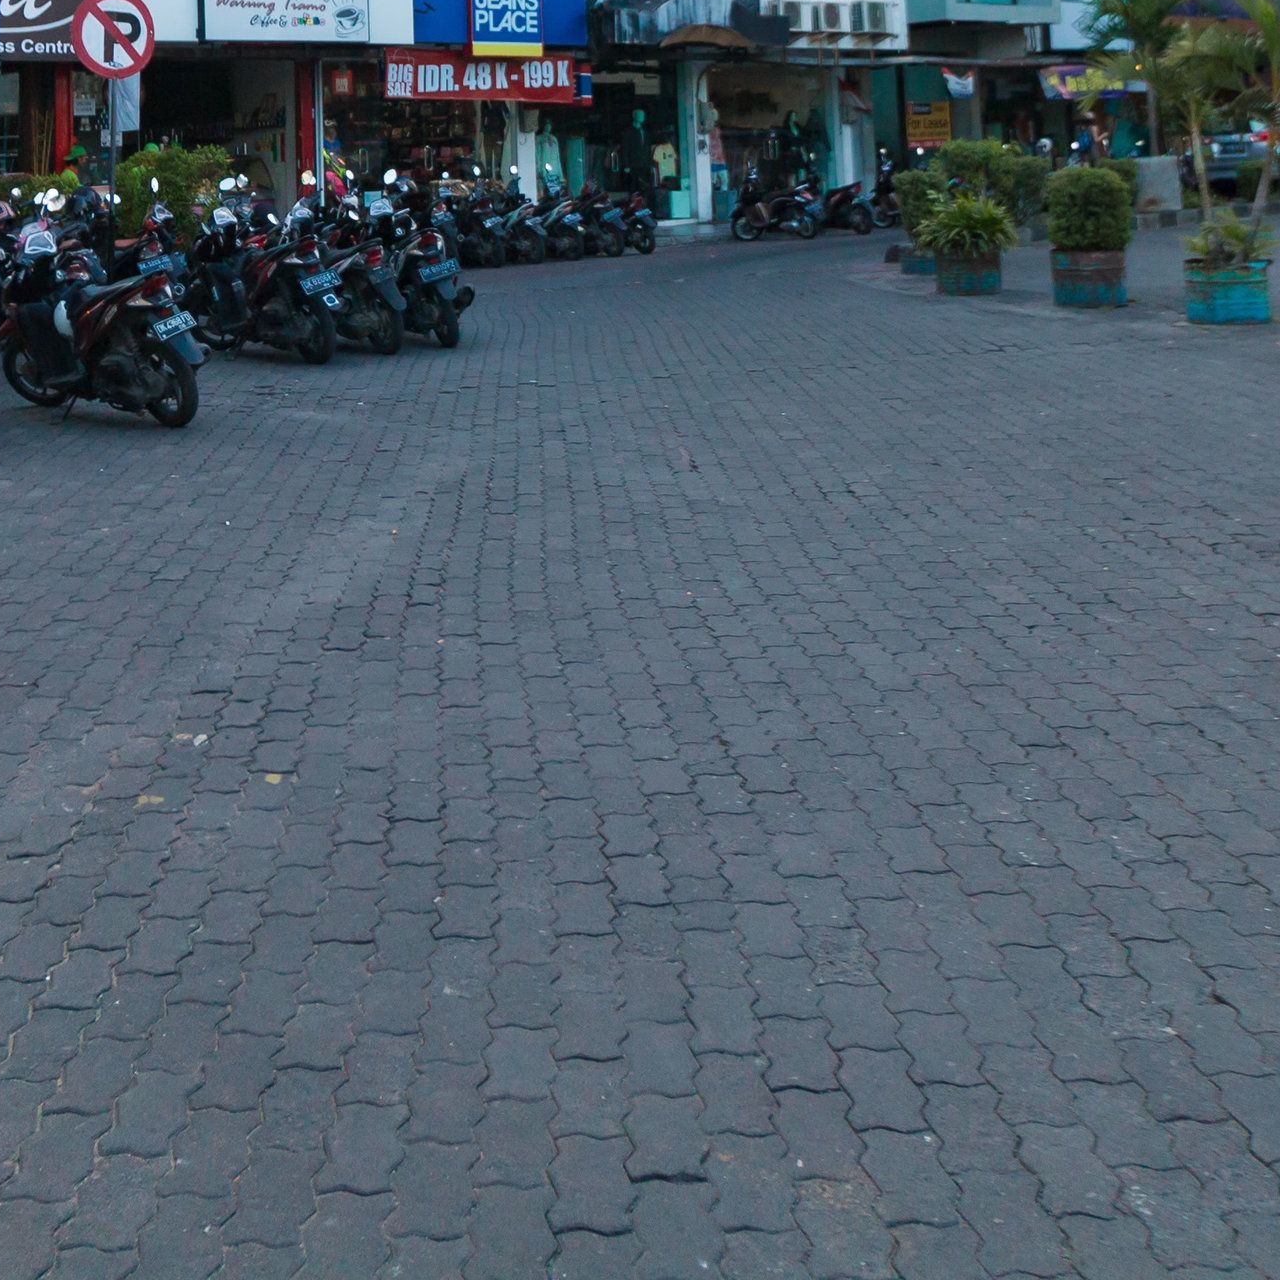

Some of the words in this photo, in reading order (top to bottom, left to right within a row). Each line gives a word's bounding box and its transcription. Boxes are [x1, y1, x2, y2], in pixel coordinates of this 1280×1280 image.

[474, 10, 539, 33] PLACE
[387, 63, 414, 83] BIG
[417, 64, 460, 93] IDR.
[462, 61, 493, 91] 48
[496, 62, 509, 89] K
[520, 60, 555, 89] 199
[557, 60, 570, 88] K
[386, 81, 413, 97] SALE
